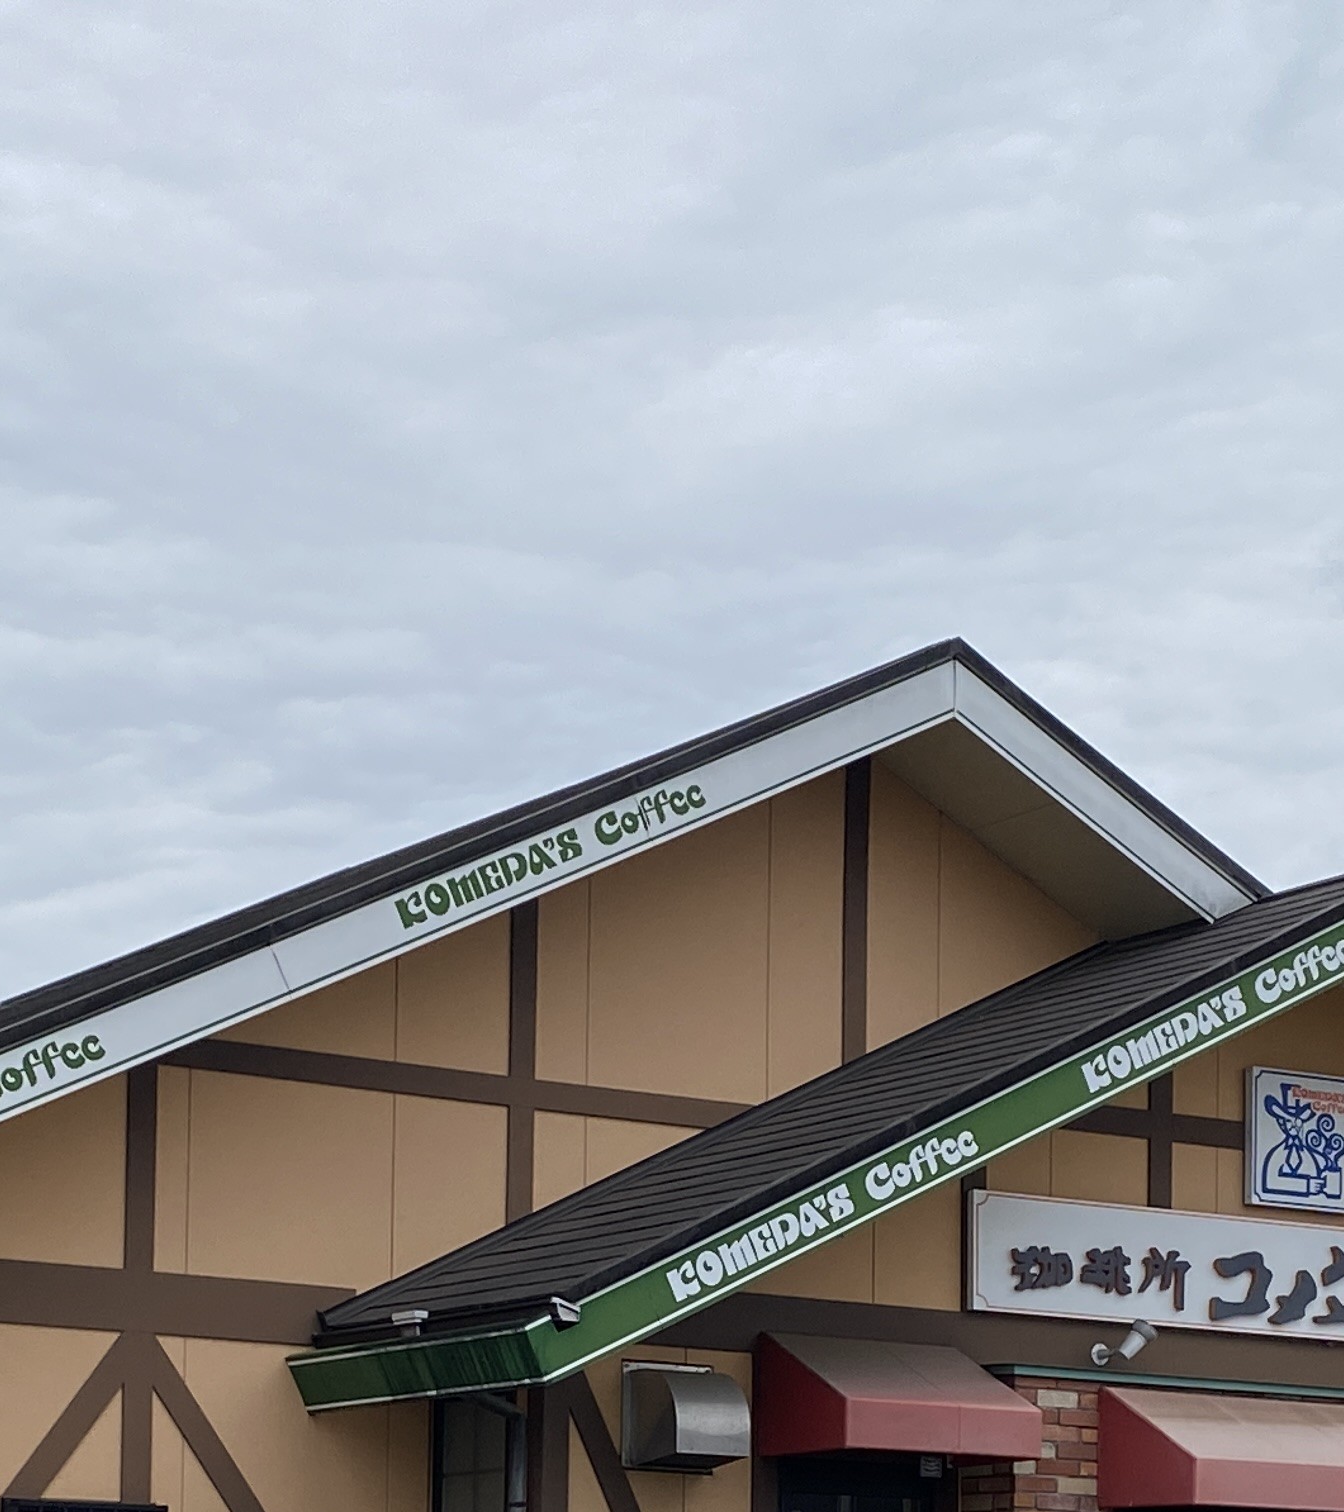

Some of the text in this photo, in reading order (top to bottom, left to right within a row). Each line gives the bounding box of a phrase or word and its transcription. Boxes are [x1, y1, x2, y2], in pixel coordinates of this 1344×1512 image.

[394, 784, 707, 929] KOMEDA'S Coffee
[1081, 984, 1247, 1094] KOMEDA'S
[666, 1130, 980, 1303] KOMEDA'S Coffee
